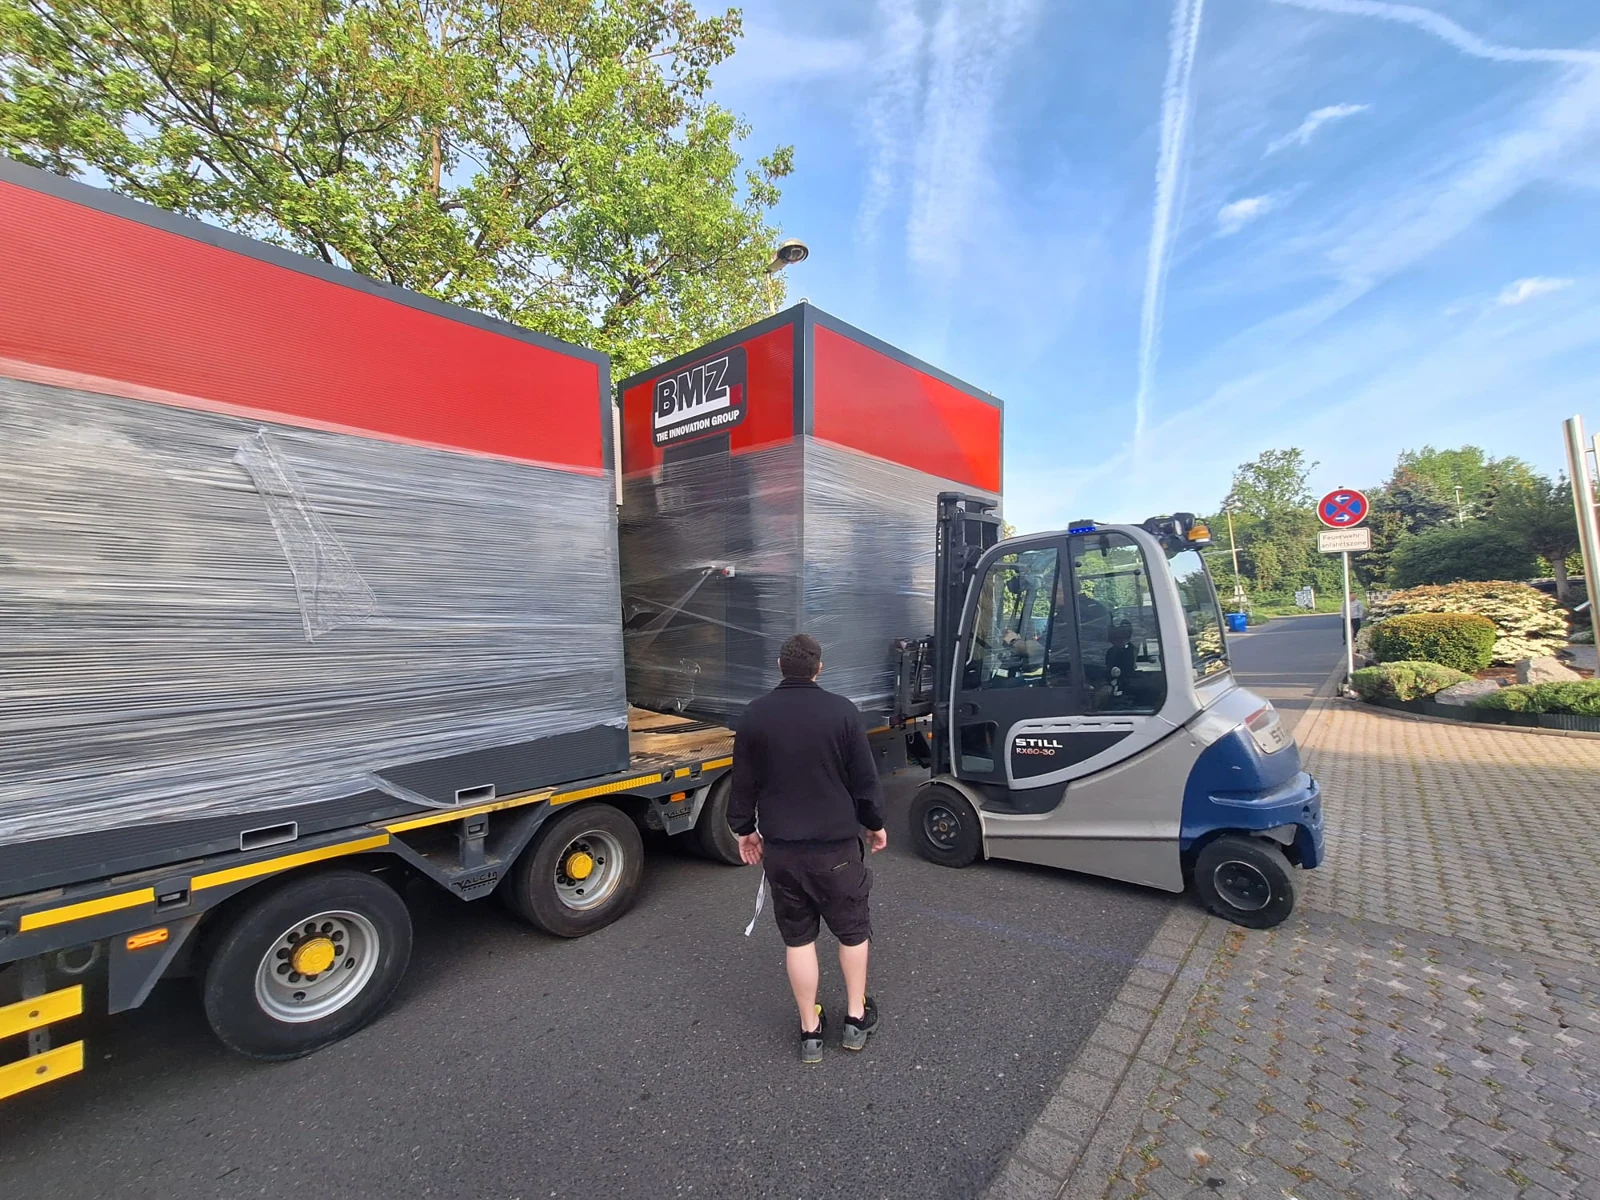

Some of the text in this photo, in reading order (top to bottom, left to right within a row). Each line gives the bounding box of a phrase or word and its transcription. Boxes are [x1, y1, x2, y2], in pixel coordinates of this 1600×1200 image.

[656, 356, 729, 421] BMZ
[656, 409, 740, 442] THE INNOVATION GROUP
[1015, 738, 1063, 748] STILL
[1016, 747, 1055, 756] RX60-30
